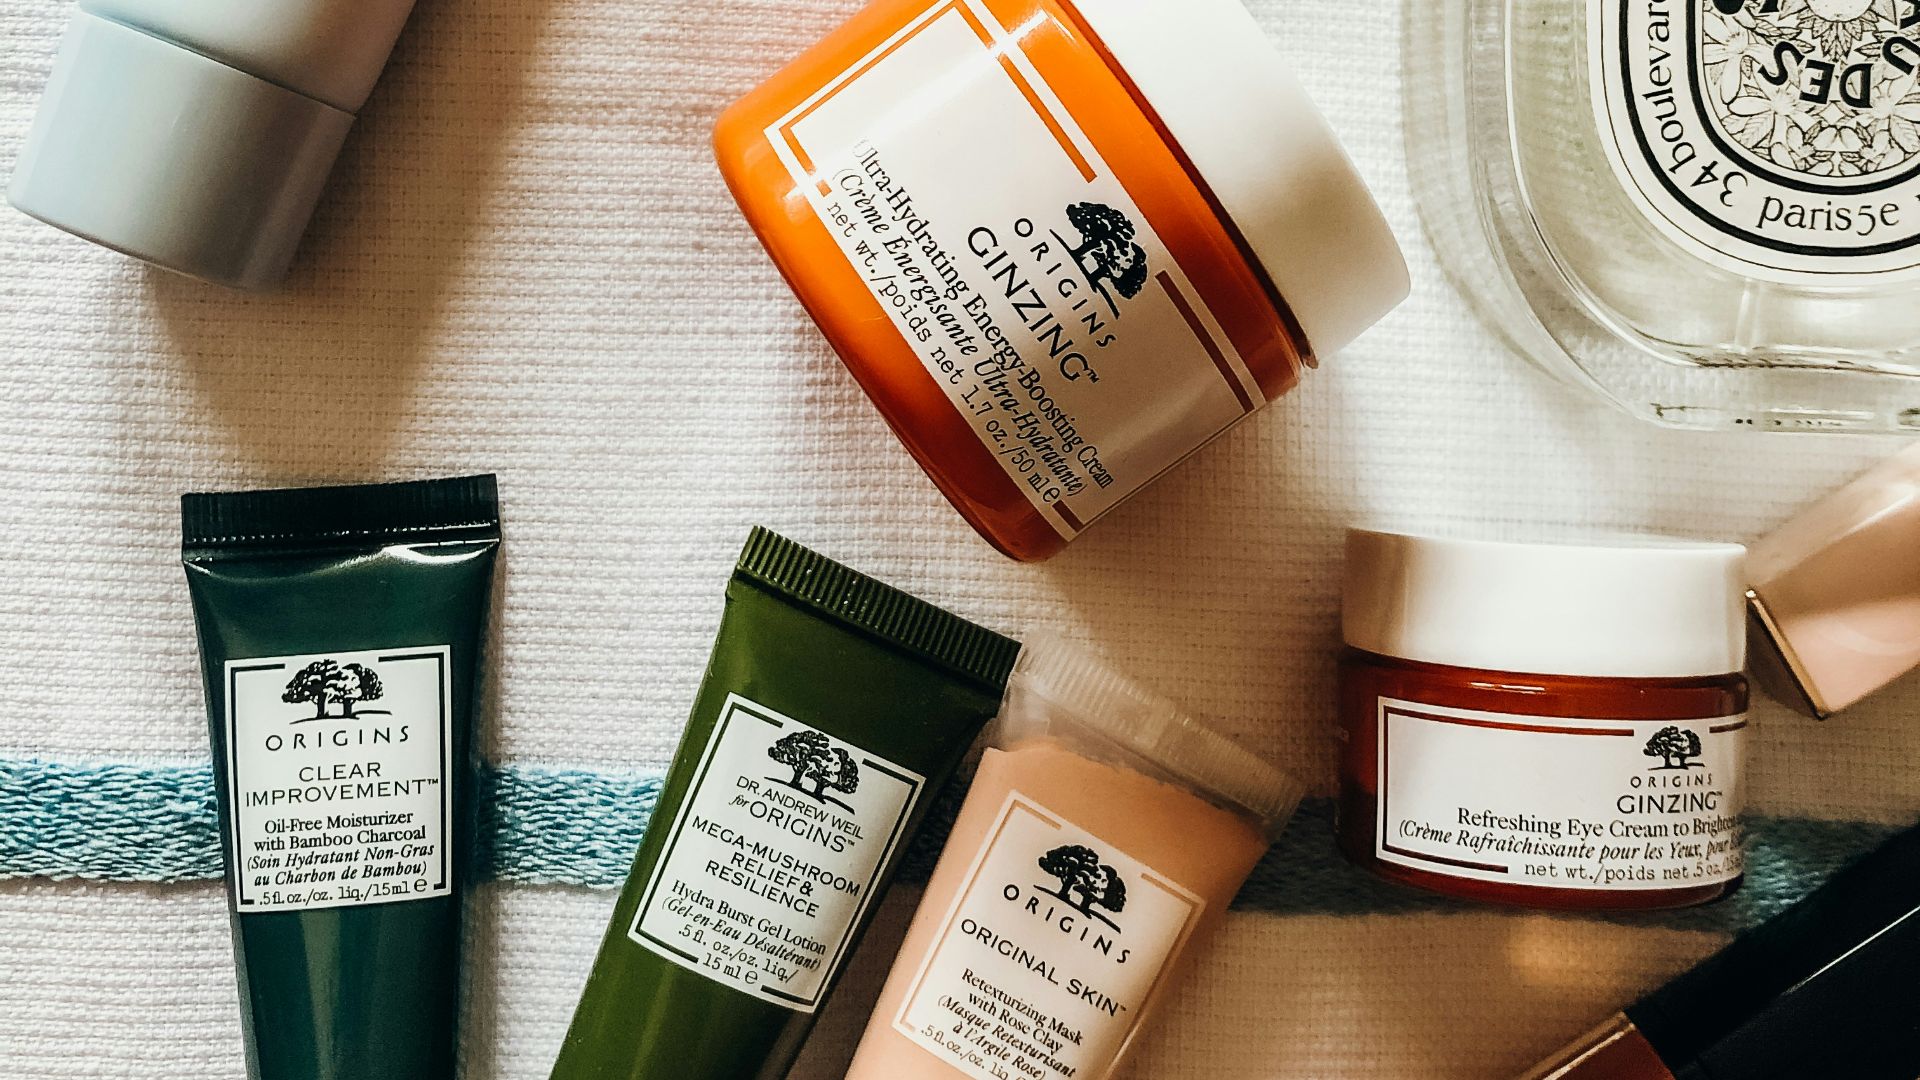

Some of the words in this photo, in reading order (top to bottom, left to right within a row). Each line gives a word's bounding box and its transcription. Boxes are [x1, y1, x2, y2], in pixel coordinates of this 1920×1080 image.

[1642, 0, 1697, 174] boulevar
[1758, 41, 1874, 109] DES
[827, 202, 858, 238] net
[930, 347, 964, 385] net
[961, 384, 993, 416] 1.7
[852, 138, 969, 300] Ultra-Hydrating
[962, 293, 1083, 454] Energy-Boosting
[1077, 446, 1115, 489] Cream
[1014, 218, 1116, 347] ORIGINS
[832, 168, 890, 234] (Crème
[974, 357, 1088, 497] Ultra-Hydratante)
[265, 725, 409, 751] ORIGINS
[299, 762, 381, 782] CLEAR
[729, 793, 750, 809] for
[1630, 773, 1712, 789] ORIGINS
[254, 836, 285, 851] with
[290, 832, 353, 849] Bamboo
[357, 825, 426, 844] Charcoal
[264, 817, 323, 834] Oil-Free
[327, 811, 413, 829] Moisturizer
[736, 775, 760, 796] DR.
[762, 789, 829, 823] ANDREW
[831, 815, 864, 840] WEIL
[1458, 807, 1562, 839] Refreshing
[1568, 819, 1604, 841] Eye
[1610, 820, 1668, 838] Cream
[1673, 822, 1689, 836] to
[247, 854, 280, 872] (Soin
[285, 849, 360, 870] Hydratant
[364, 843, 435, 860] Non-Gras
[691, 816, 861, 897] MEGA-MUSHROOM
[1399, 819, 1452, 843] (Crème
[1456, 829, 1595, 858] Rafraîchissante
[1599, 844, 1641, 864] pour
[1644, 842, 1664, 859] les
[1524, 863, 1558, 877] net
[1663, 866, 1689, 879] net
[254, 875, 270, 886] au
[275, 868, 336, 885] Charbon
[341, 865, 357, 880] de
[362, 861, 427, 880] Bambou)
[705, 860, 820, 917] RESILIENCE
[662, 896, 742, 941] (Gel-en-Eau
[743, 933, 822, 972] Désaltérant)
[672, 880, 714, 910] Hydra
[718, 900, 755, 927] Burst
[758, 918, 782, 938] Gel
[783, 929, 827, 955] Lotion
[1003, 884, 1130, 964] ORIGINS
[702, 952, 723, 970] 15
[723, 965, 742, 980] ml
[961, 918, 1059, 986] ORIGINAL
[938, 994, 991, 1030] (Masque
[992, 1027, 1077, 1078] Retexturisant
[961, 968, 1048, 1028] Retexturizing
[1050, 1017, 1084, 1046] Mask
[969, 993, 997, 1017] with
[1000, 1009, 1031, 1034] Rose
[1033, 1028, 1064, 1056] Clay
[953, 1021, 964, 1034] à
[1012, 1055, 1047, 1080] Rose)
